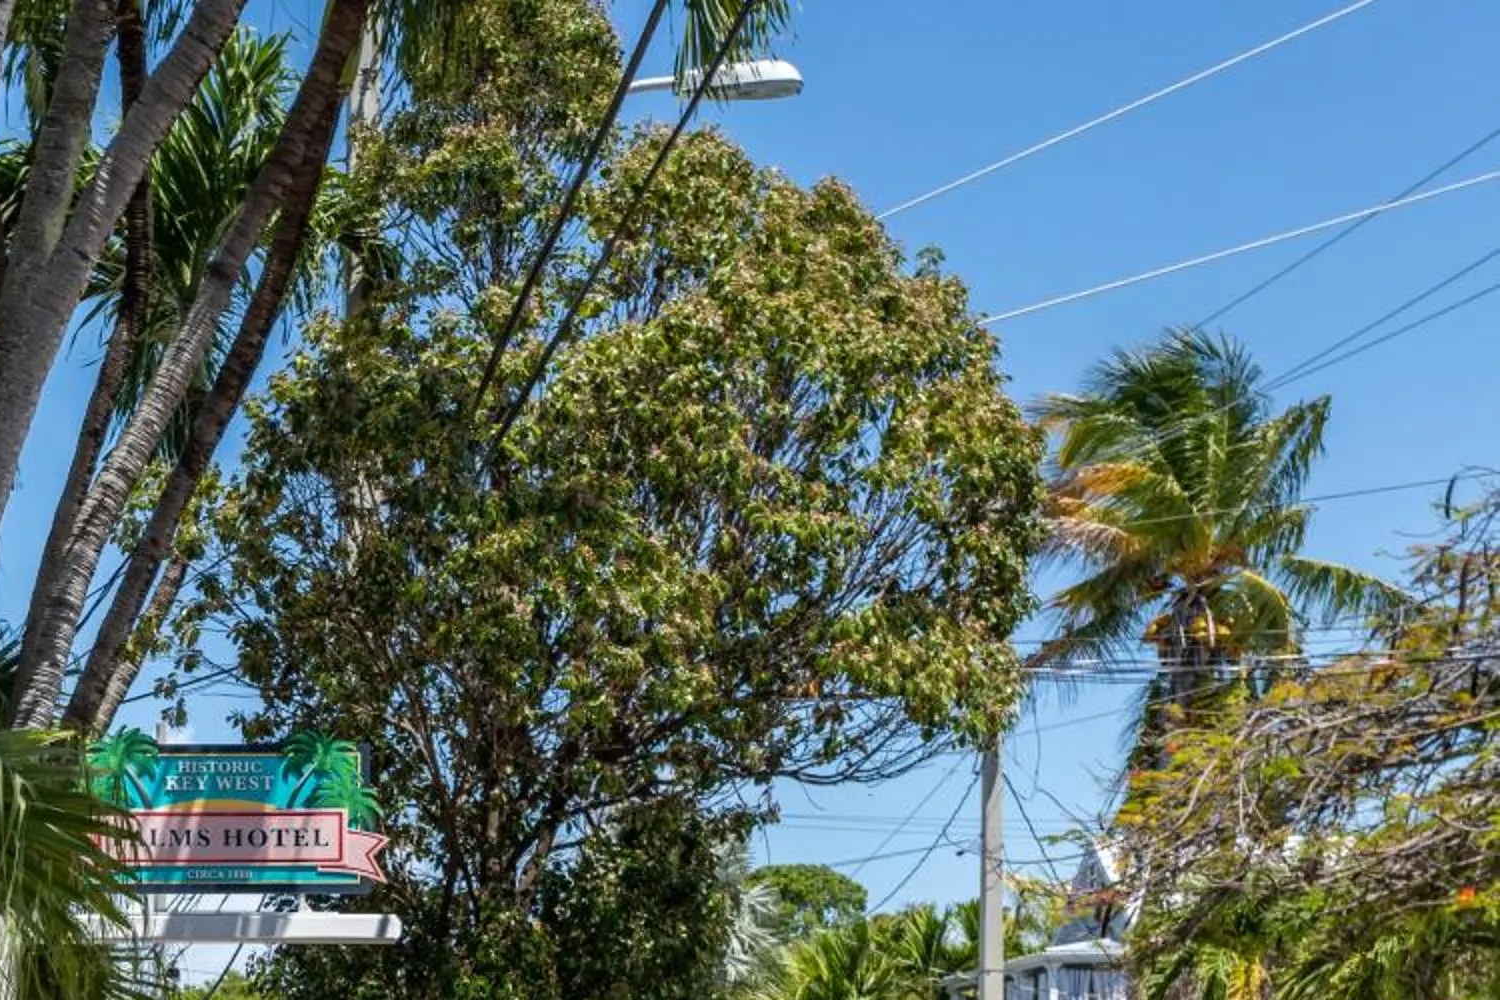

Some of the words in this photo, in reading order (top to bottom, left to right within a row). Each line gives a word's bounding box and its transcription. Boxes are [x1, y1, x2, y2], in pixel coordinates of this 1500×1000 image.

[178, 760, 262, 773] HISTORIC
[164, 775, 208, 791] KEY
[215, 775, 274, 791] WEST
[126, 828, 211, 848] LMS
[223, 828, 329, 848] HOTEL
